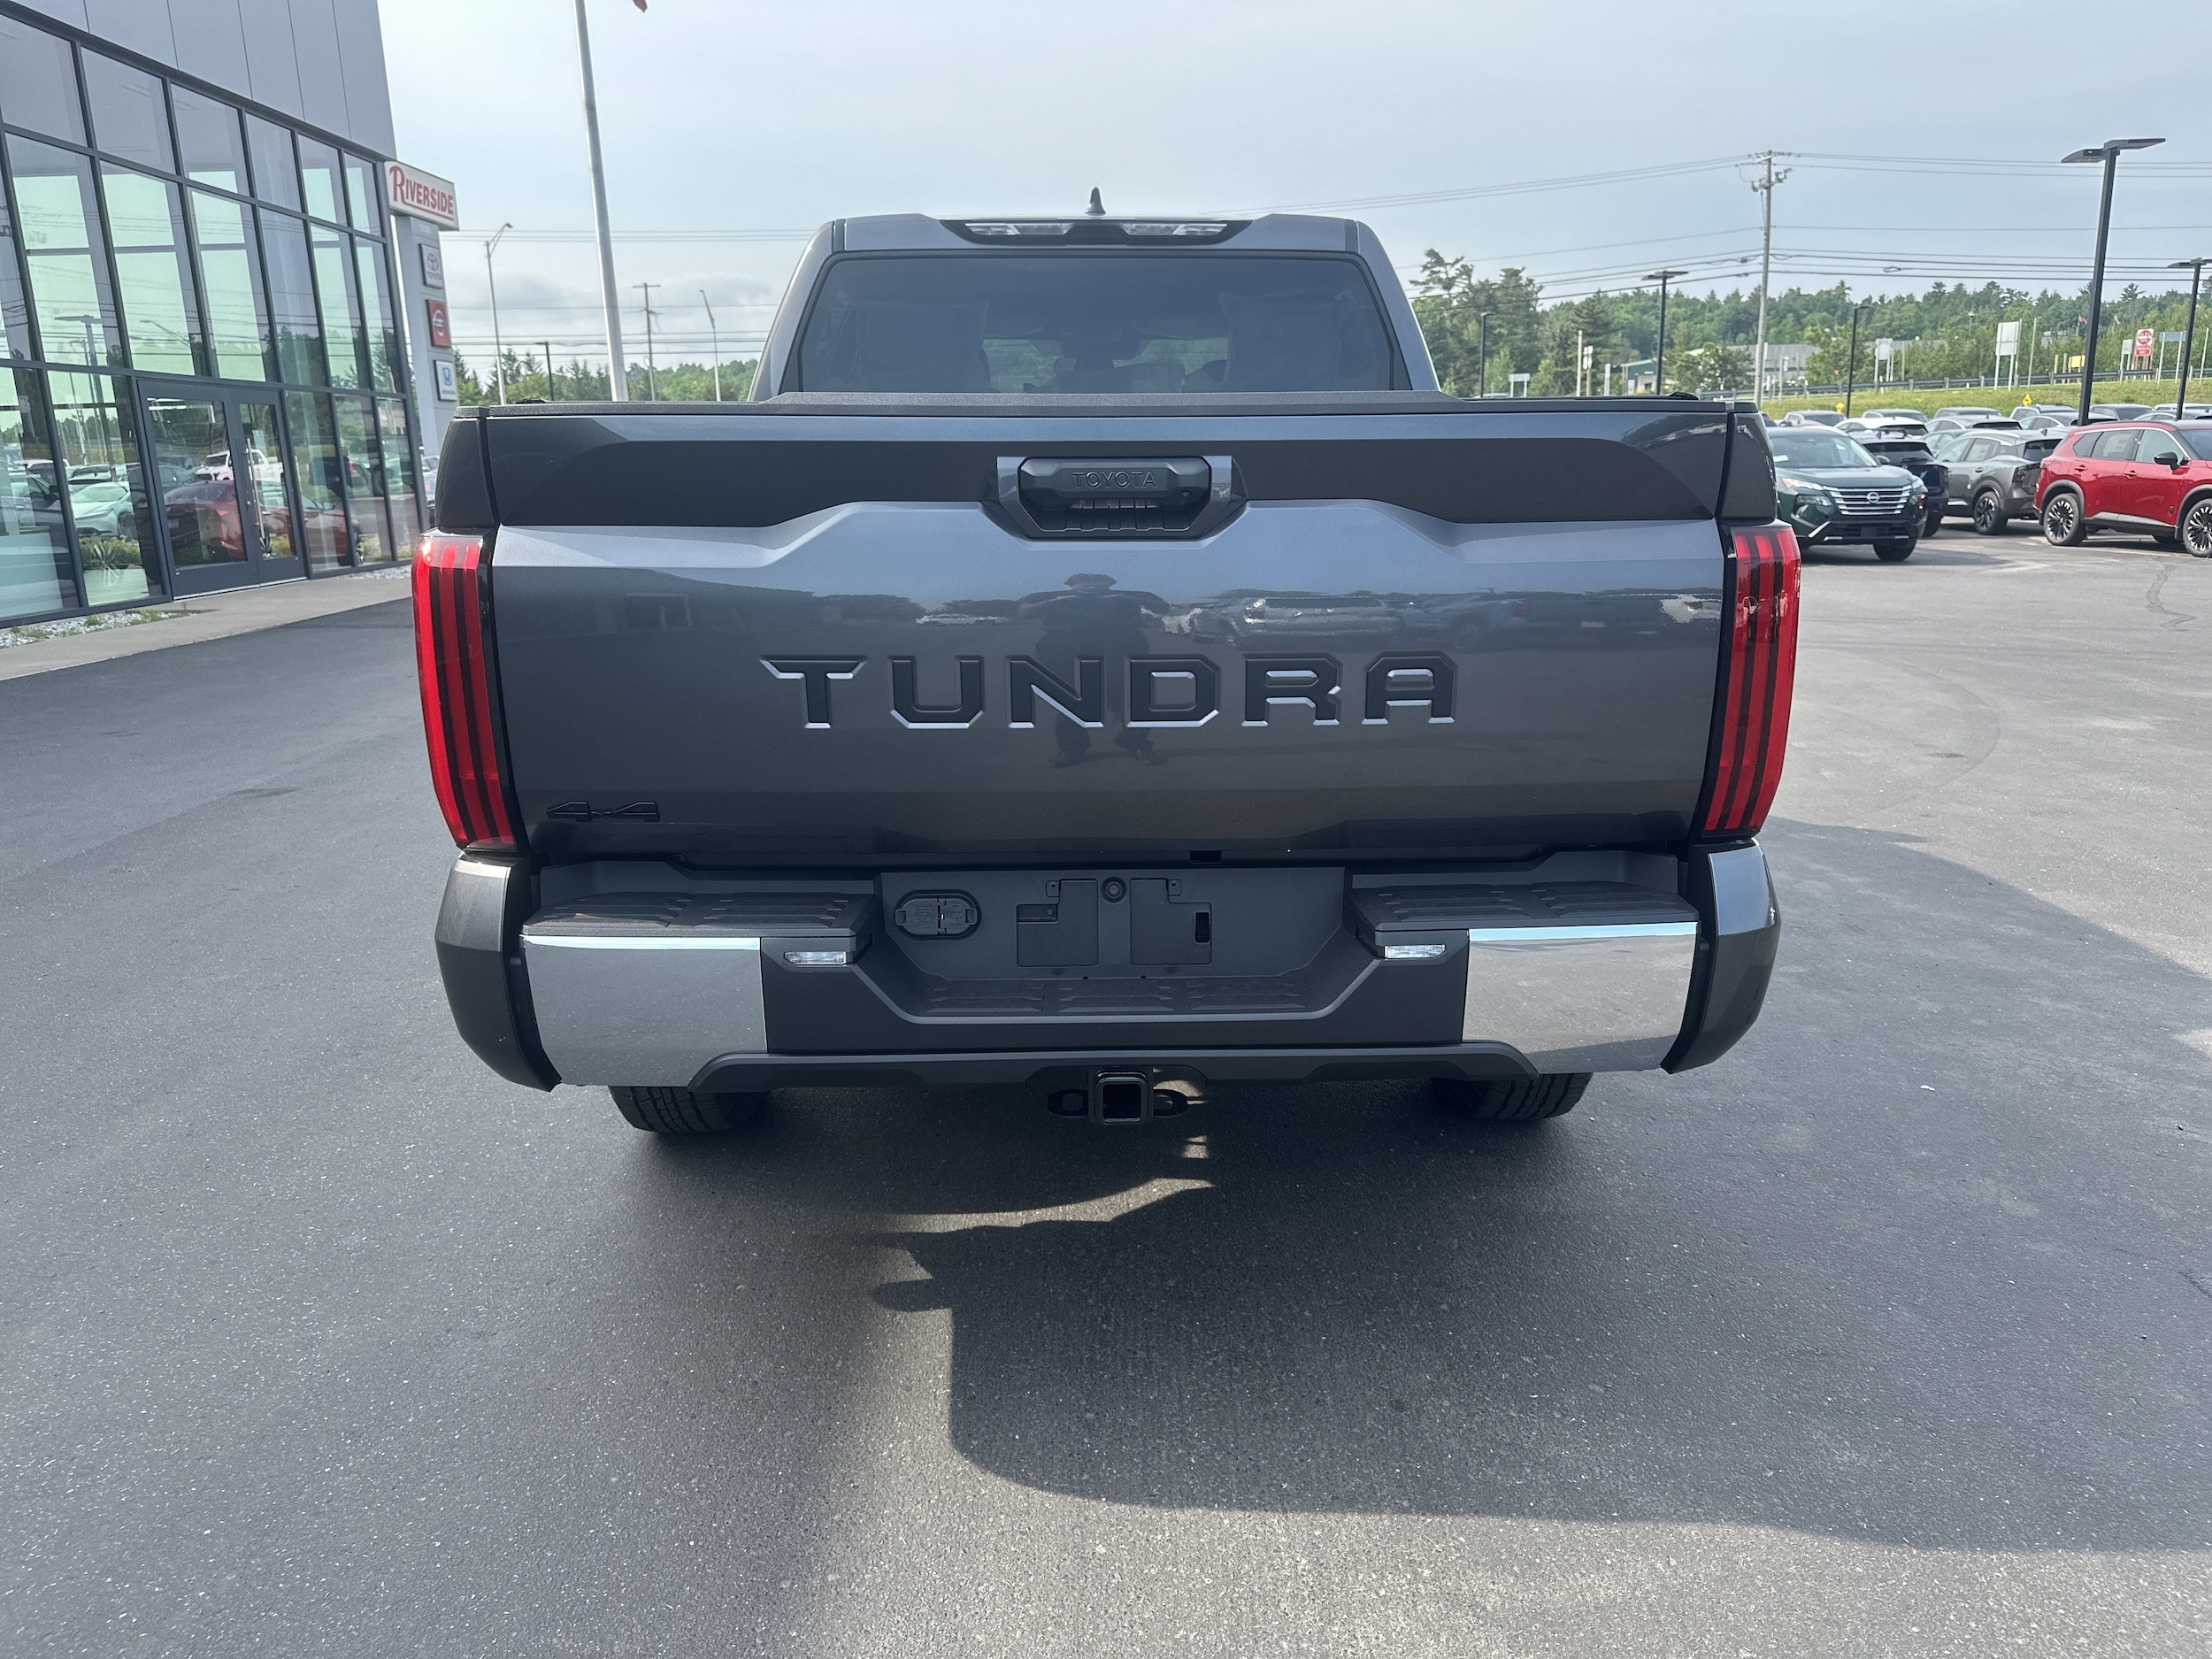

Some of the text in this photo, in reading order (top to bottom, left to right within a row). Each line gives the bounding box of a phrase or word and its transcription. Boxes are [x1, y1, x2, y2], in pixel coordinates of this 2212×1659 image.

[389, 165, 454, 217] RIVERSIDE
[1072, 471, 1158, 488] TOYOTA
[759, 650, 1459, 730] TUNDRA
